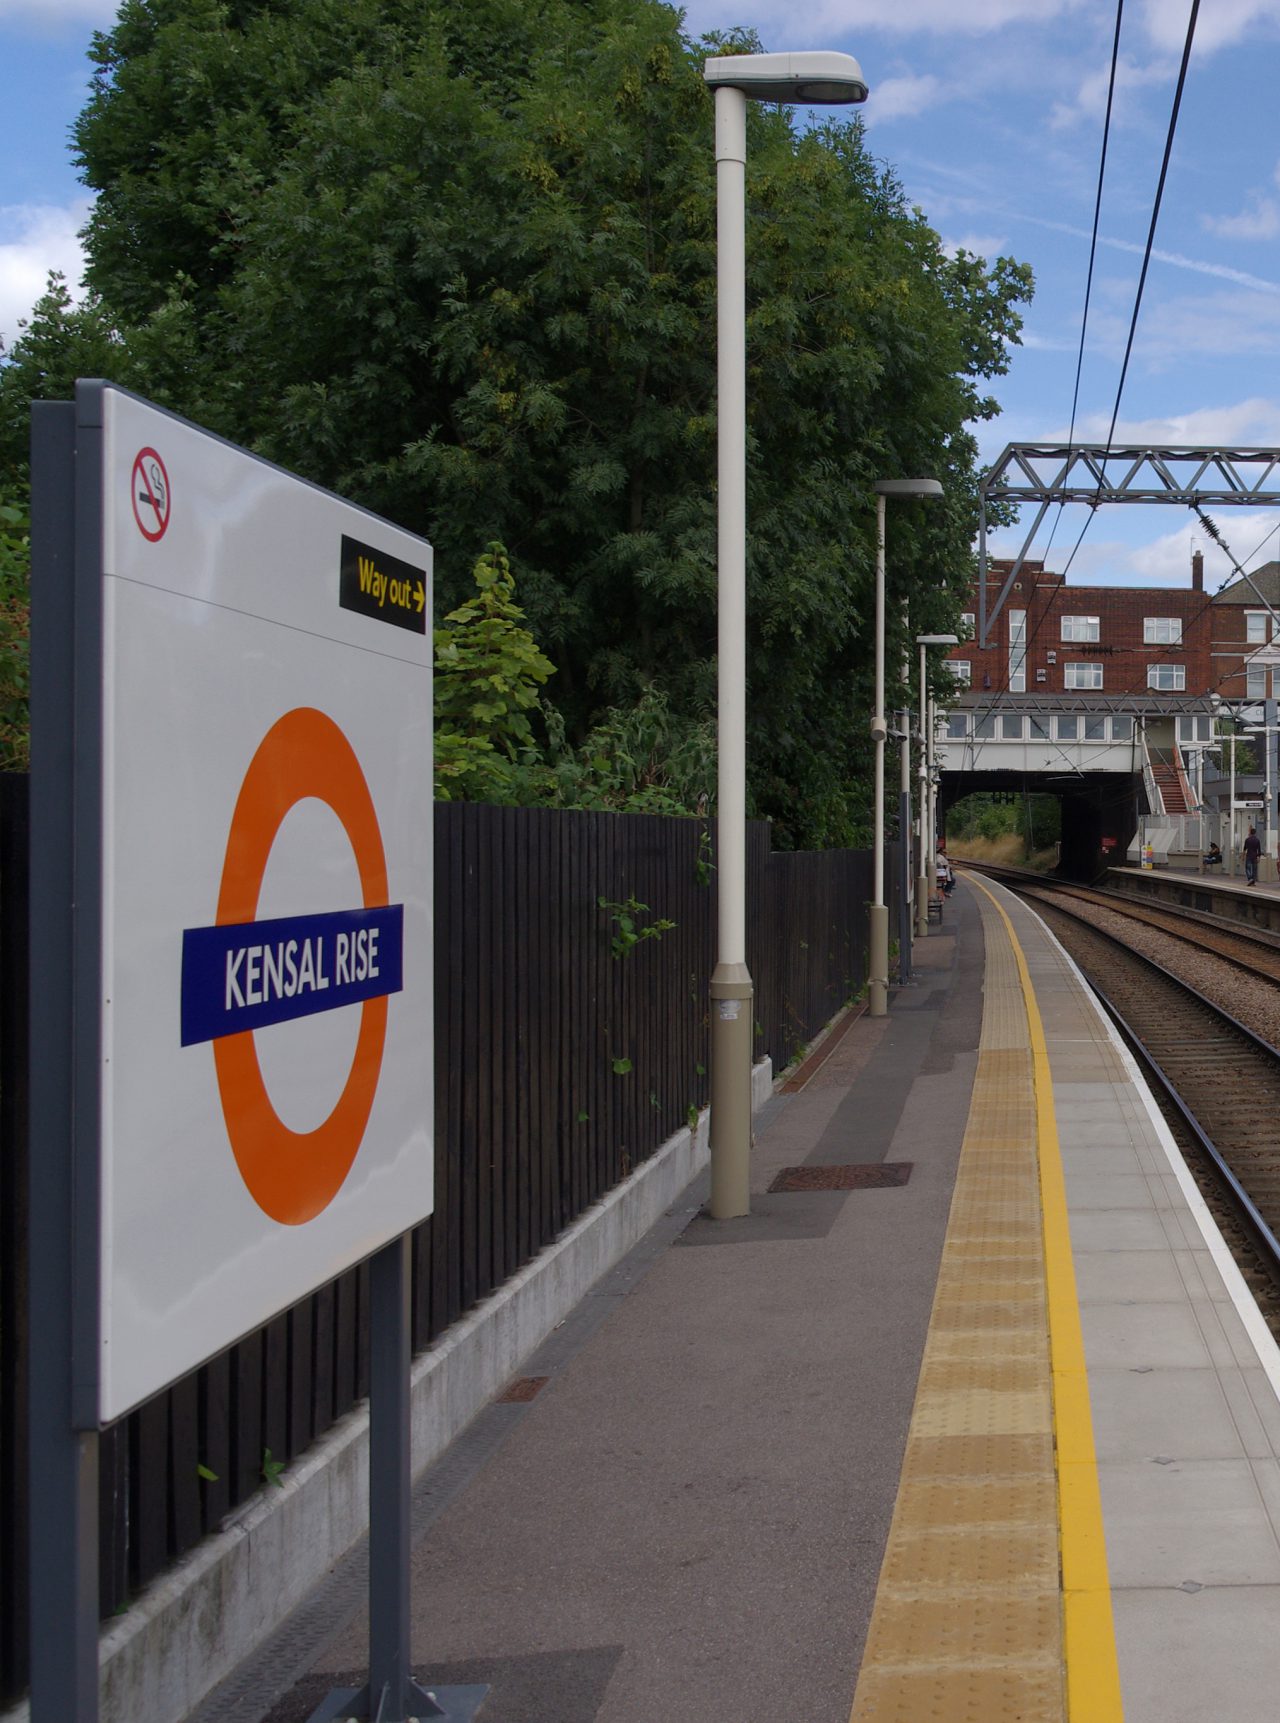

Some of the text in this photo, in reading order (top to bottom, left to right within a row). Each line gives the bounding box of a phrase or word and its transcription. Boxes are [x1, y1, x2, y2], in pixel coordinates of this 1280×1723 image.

[358, 555, 412, 609] Way out
[225, 927, 380, 1011] KENSAL RISE
